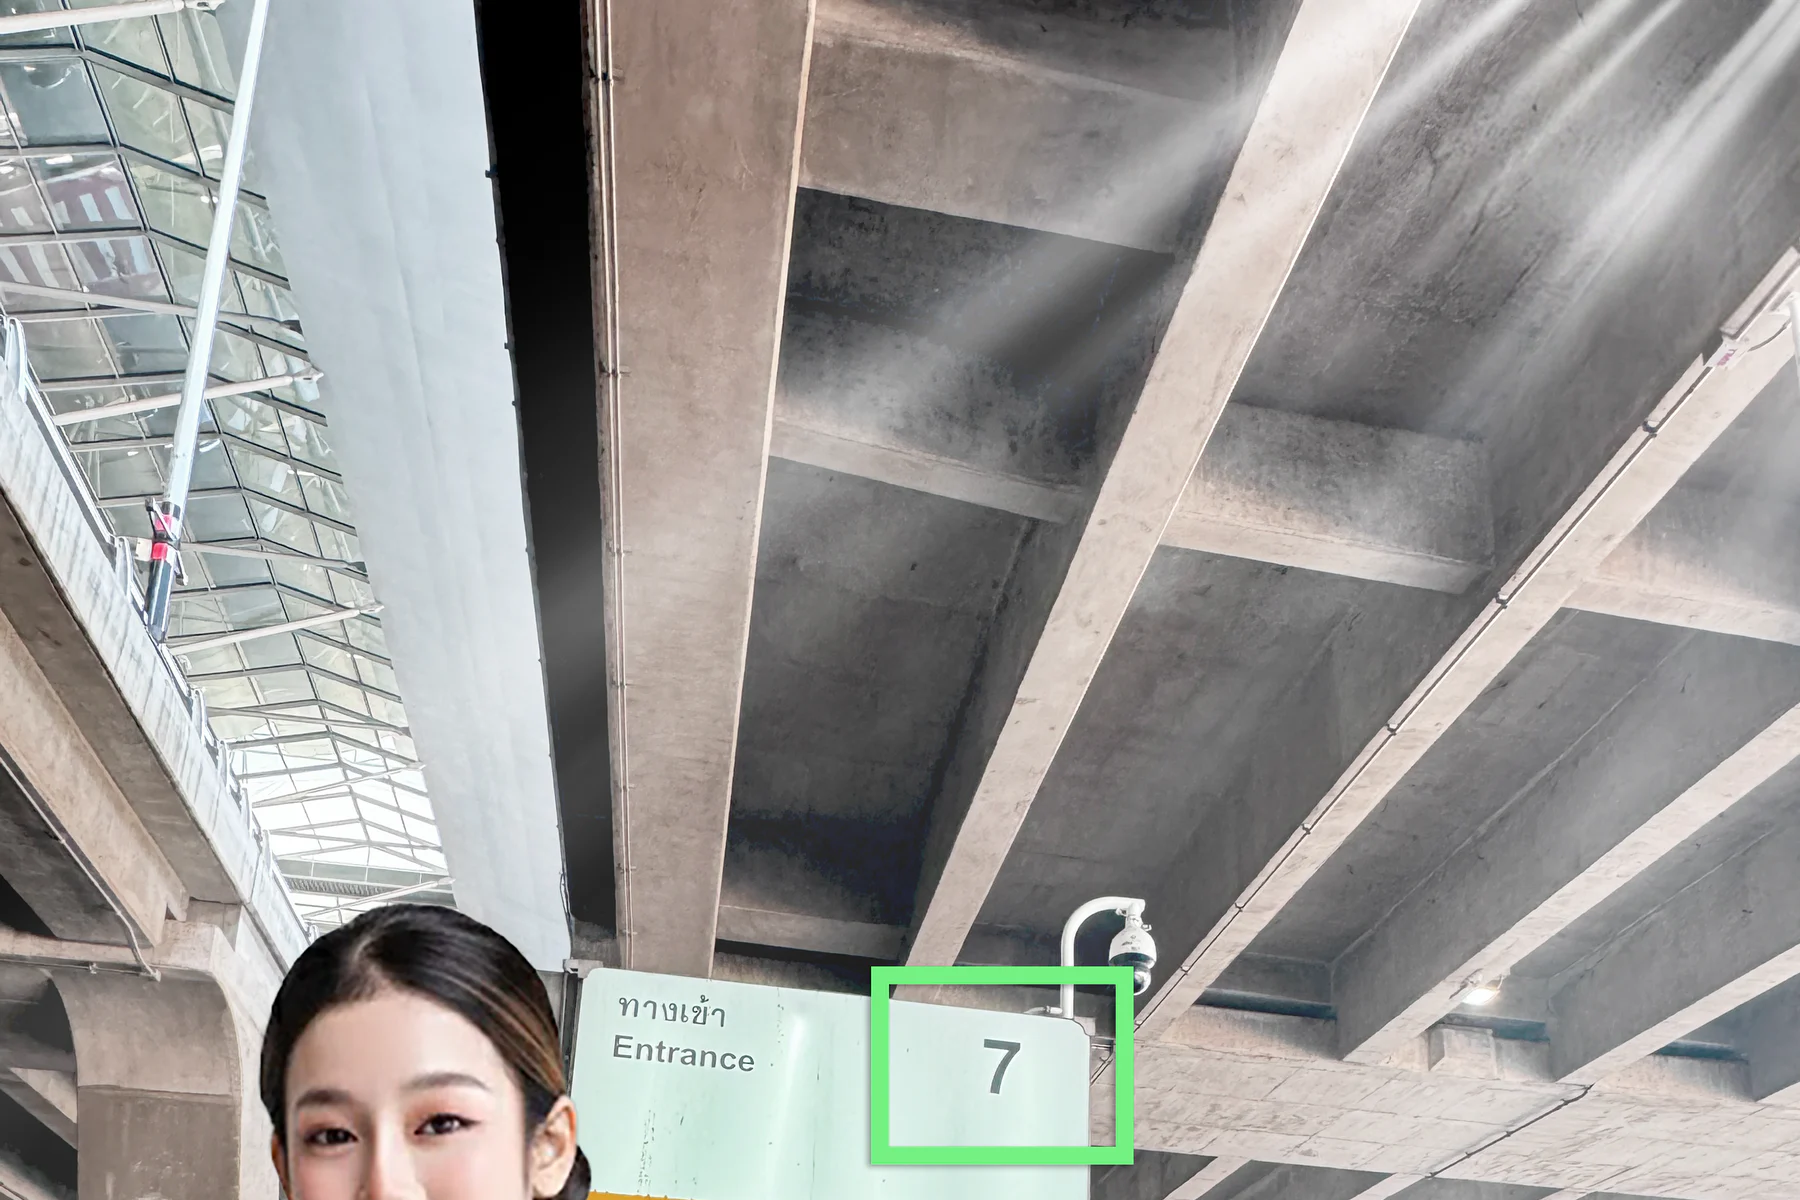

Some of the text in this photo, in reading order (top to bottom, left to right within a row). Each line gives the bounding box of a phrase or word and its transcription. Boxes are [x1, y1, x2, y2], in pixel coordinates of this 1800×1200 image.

[618, 994, 726, 1028] ทางเข้า
[613, 1034, 755, 1072] Entrance
[983, 1038, 1021, 1095] 7
